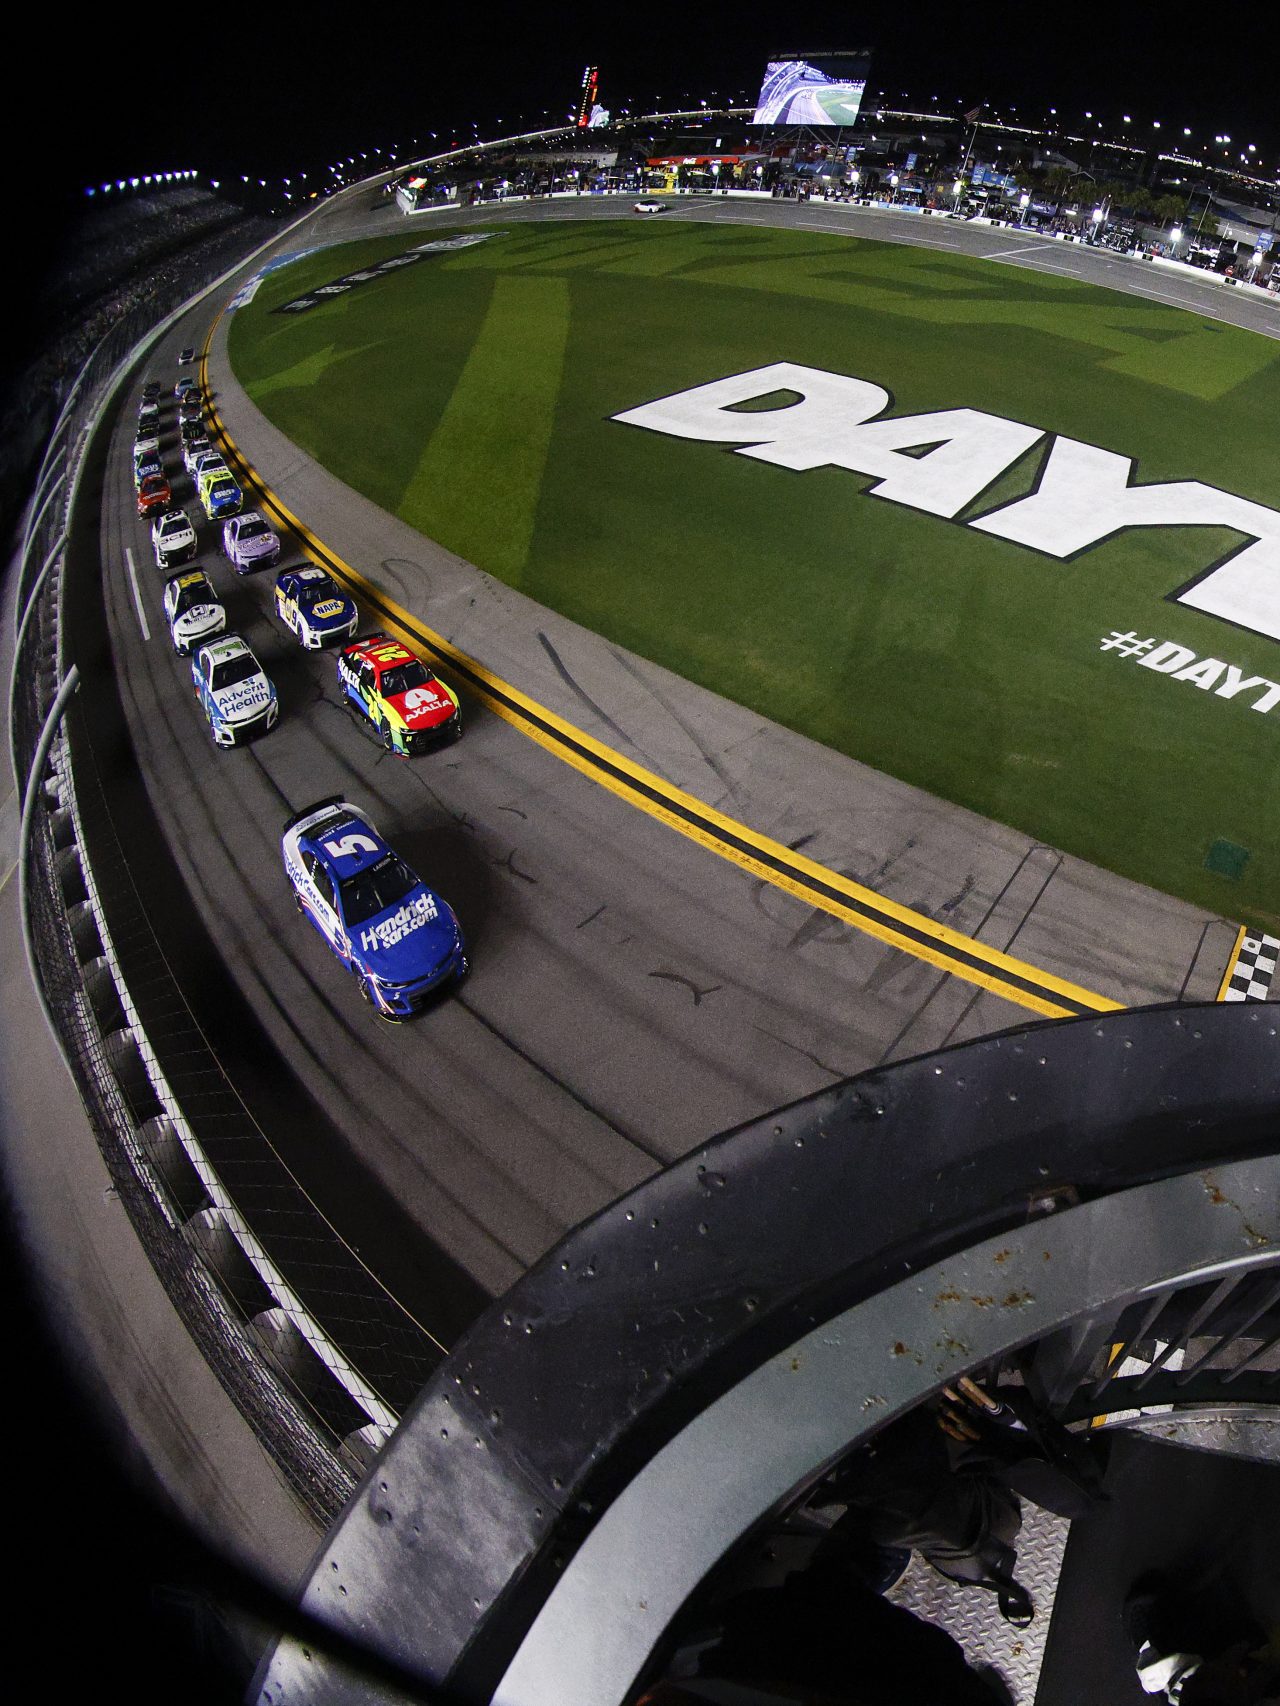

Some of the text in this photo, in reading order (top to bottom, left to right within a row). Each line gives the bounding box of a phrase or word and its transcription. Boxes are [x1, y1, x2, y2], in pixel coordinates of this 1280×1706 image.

[316, 601, 341, 615] NAPA
[219, 682, 266, 707] Advent
[225, 691, 272, 717] Health
[405, 699, 453, 722] AXALTA
[324, 834, 379, 858] 5
[361, 893, 436, 951] Hendrick
[384, 905, 439, 950] cars.com
